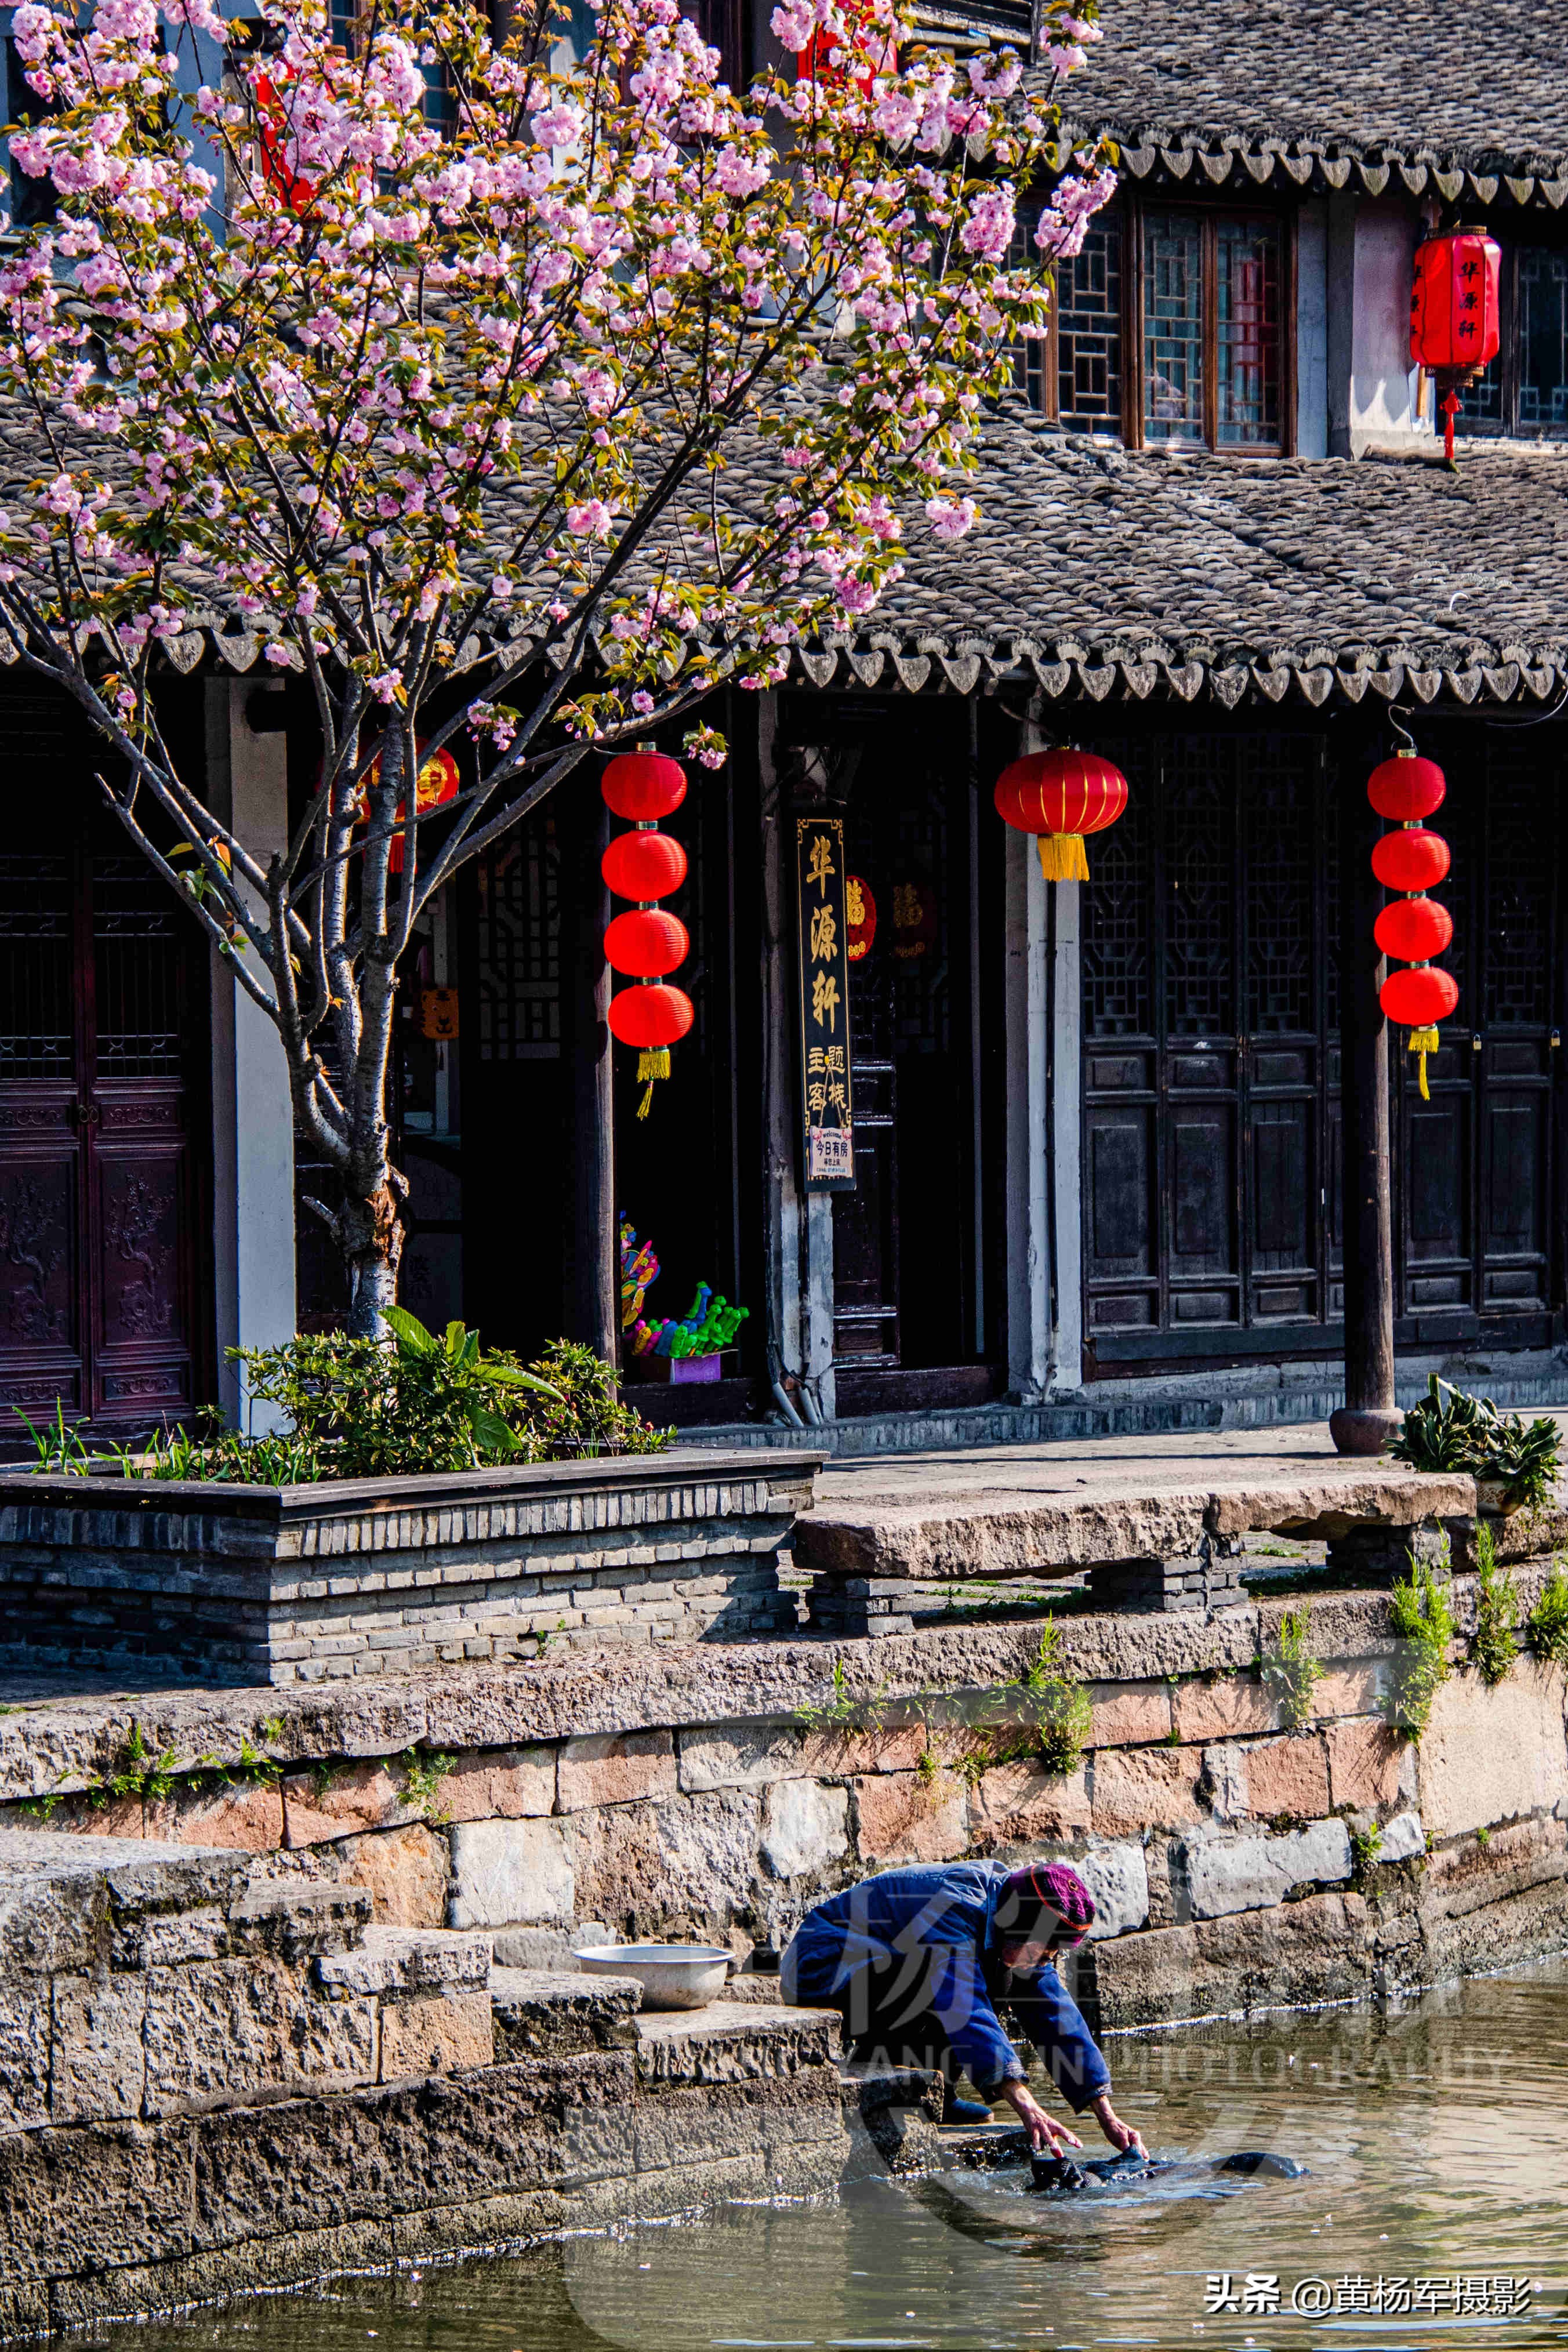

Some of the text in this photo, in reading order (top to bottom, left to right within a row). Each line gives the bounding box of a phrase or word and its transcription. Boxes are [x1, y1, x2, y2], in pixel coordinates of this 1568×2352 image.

[1458, 261, 1480, 340] 华源轩
[806, 835, 840, 1033] 华源轩
[808, 1046, 845, 1074] 主题
[808, 1082, 847, 1111] 客栈
[816, 1140, 848, 1157] 今日有房
